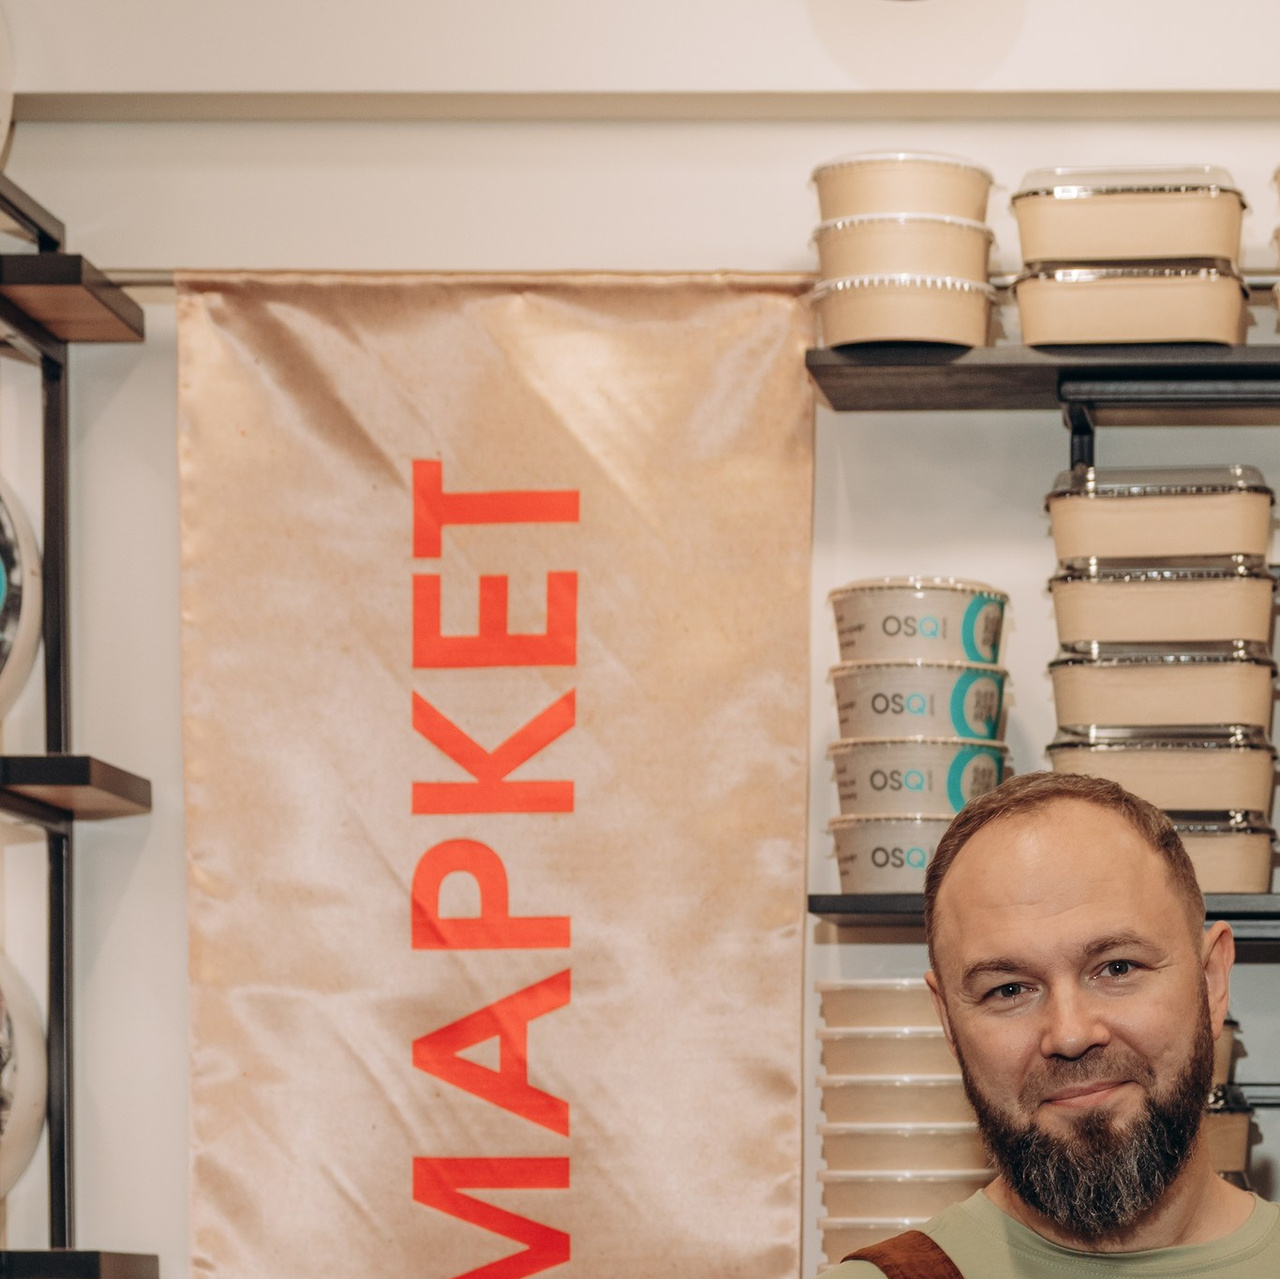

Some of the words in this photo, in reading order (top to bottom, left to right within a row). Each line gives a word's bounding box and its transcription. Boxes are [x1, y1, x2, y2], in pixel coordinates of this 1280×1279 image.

[882, 615, 939, 637] OSQ
[871, 692, 927, 715] OSQ
[870, 769, 925, 792] OSQ
[871, 846, 927, 869] OSQ
